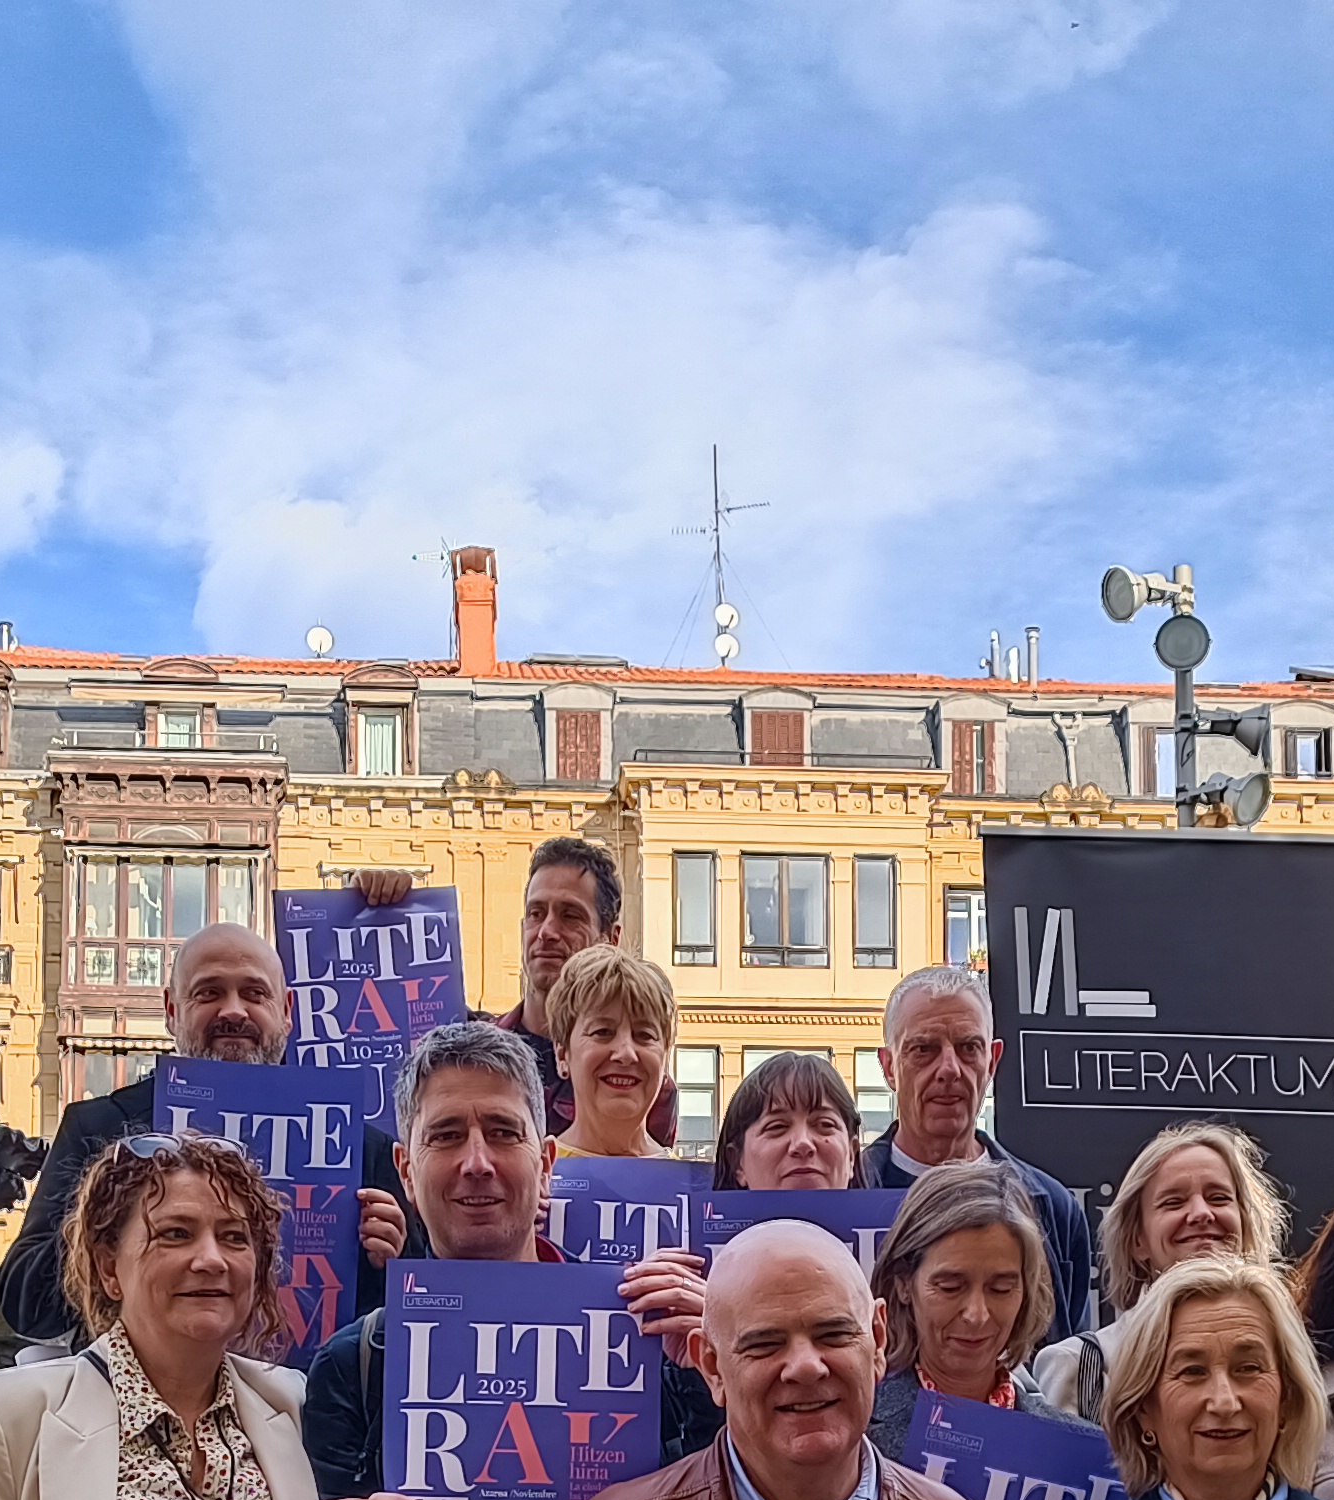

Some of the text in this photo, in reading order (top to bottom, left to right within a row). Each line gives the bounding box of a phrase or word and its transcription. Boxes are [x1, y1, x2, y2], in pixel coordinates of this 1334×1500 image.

[285, 911, 451, 984] LITE
[341, 963, 375, 976] 2025
[350, 1043, 404, 1060] 10-23
[599, 1243, 637, 1259] 2025
[400, 1310, 644, 1407] LITE
[478, 1378, 527, 1399] 2025
